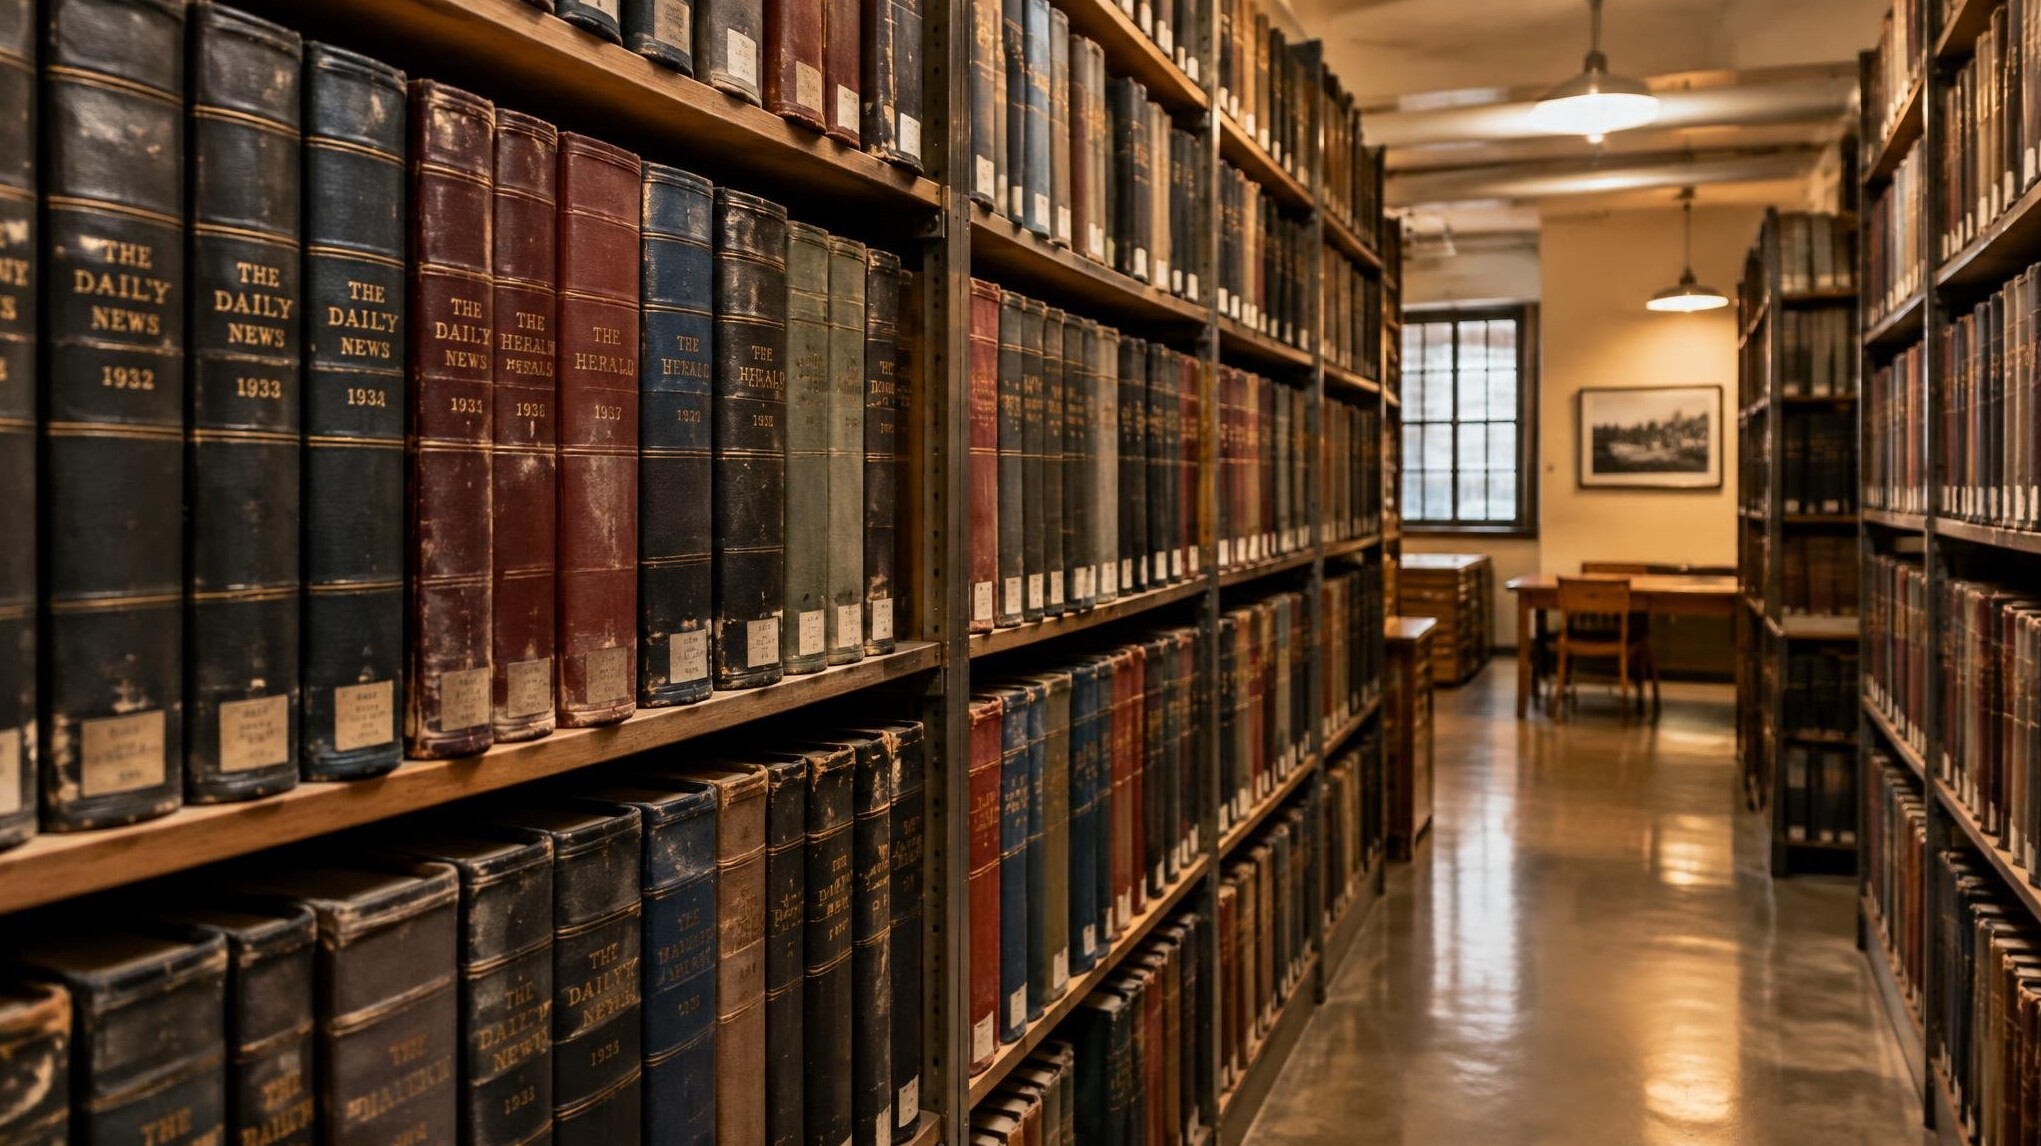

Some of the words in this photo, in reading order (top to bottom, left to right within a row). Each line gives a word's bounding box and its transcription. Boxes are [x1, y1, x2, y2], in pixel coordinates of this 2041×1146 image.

[104, 239, 152, 269] THE
[74, 269, 172, 304] DAILY
[237, 261, 280, 288] THE
[348, 280, 385, 303] THE
[214, 290, 293, 320] DAILY
[451, 298, 482, 319] THE
[92, 305, 161, 335] NEWS
[328, 306, 399, 333] DAILY
[516, 311, 545, 332] THE
[228, 322, 285, 348] NEWS
[434, 321, 492, 346] DAILY
[592, 326, 621, 346] THE
[341, 337, 391, 359] NEWS
[445, 350, 488, 370] NEWS
[574, 352, 634, 377] HERALD
[102, 365, 154, 390] 1932
[237, 377, 282, 399] 1933
[595, 405, 622, 421] 1937
